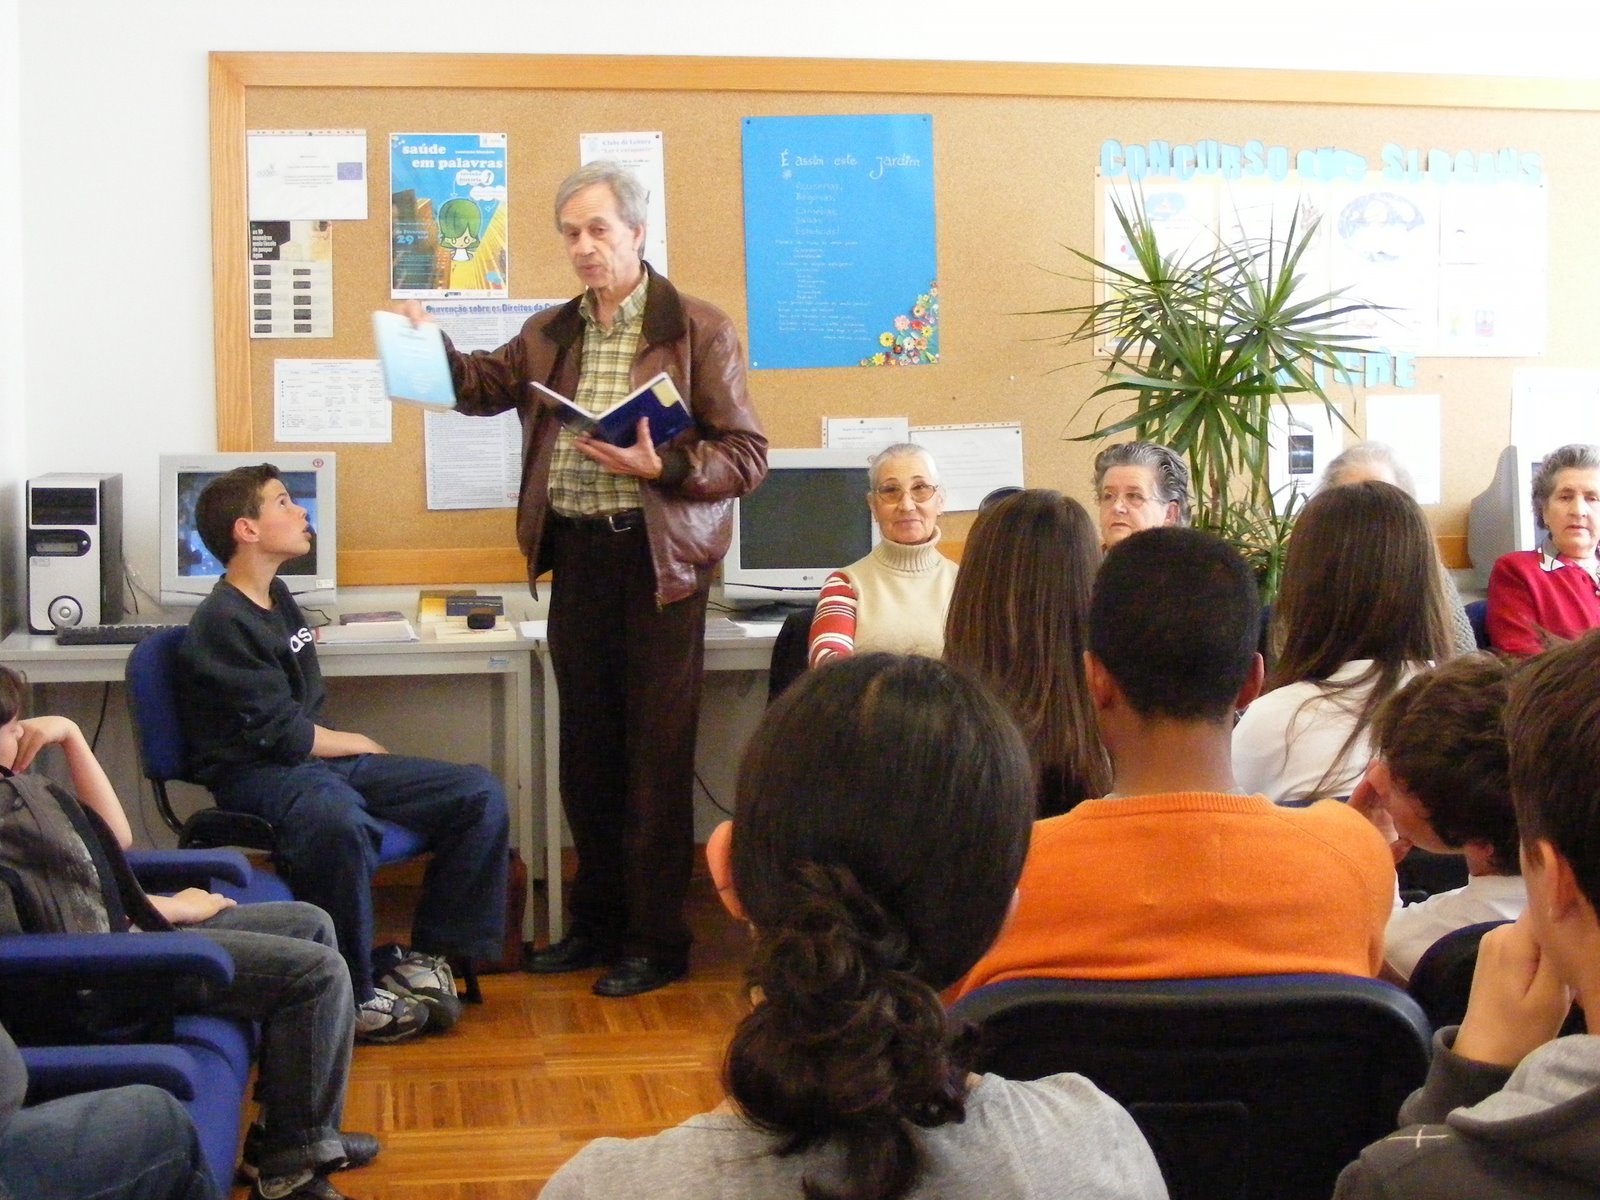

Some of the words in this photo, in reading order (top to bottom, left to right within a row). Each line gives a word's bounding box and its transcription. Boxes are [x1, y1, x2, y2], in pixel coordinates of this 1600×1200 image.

[402, 143, 446, 154] saúde
[781, 148, 789, 167] É
[1100, 139, 1289, 182] CONCURSO
[412, 159, 434, 168] em
[438, 158, 503, 170] palavras
[396, 234, 415, 245] 29
[426, 304, 467, 316] Convenção
[469, 304, 490, 312] sobre
[502, 304, 532, 312] Direitos
